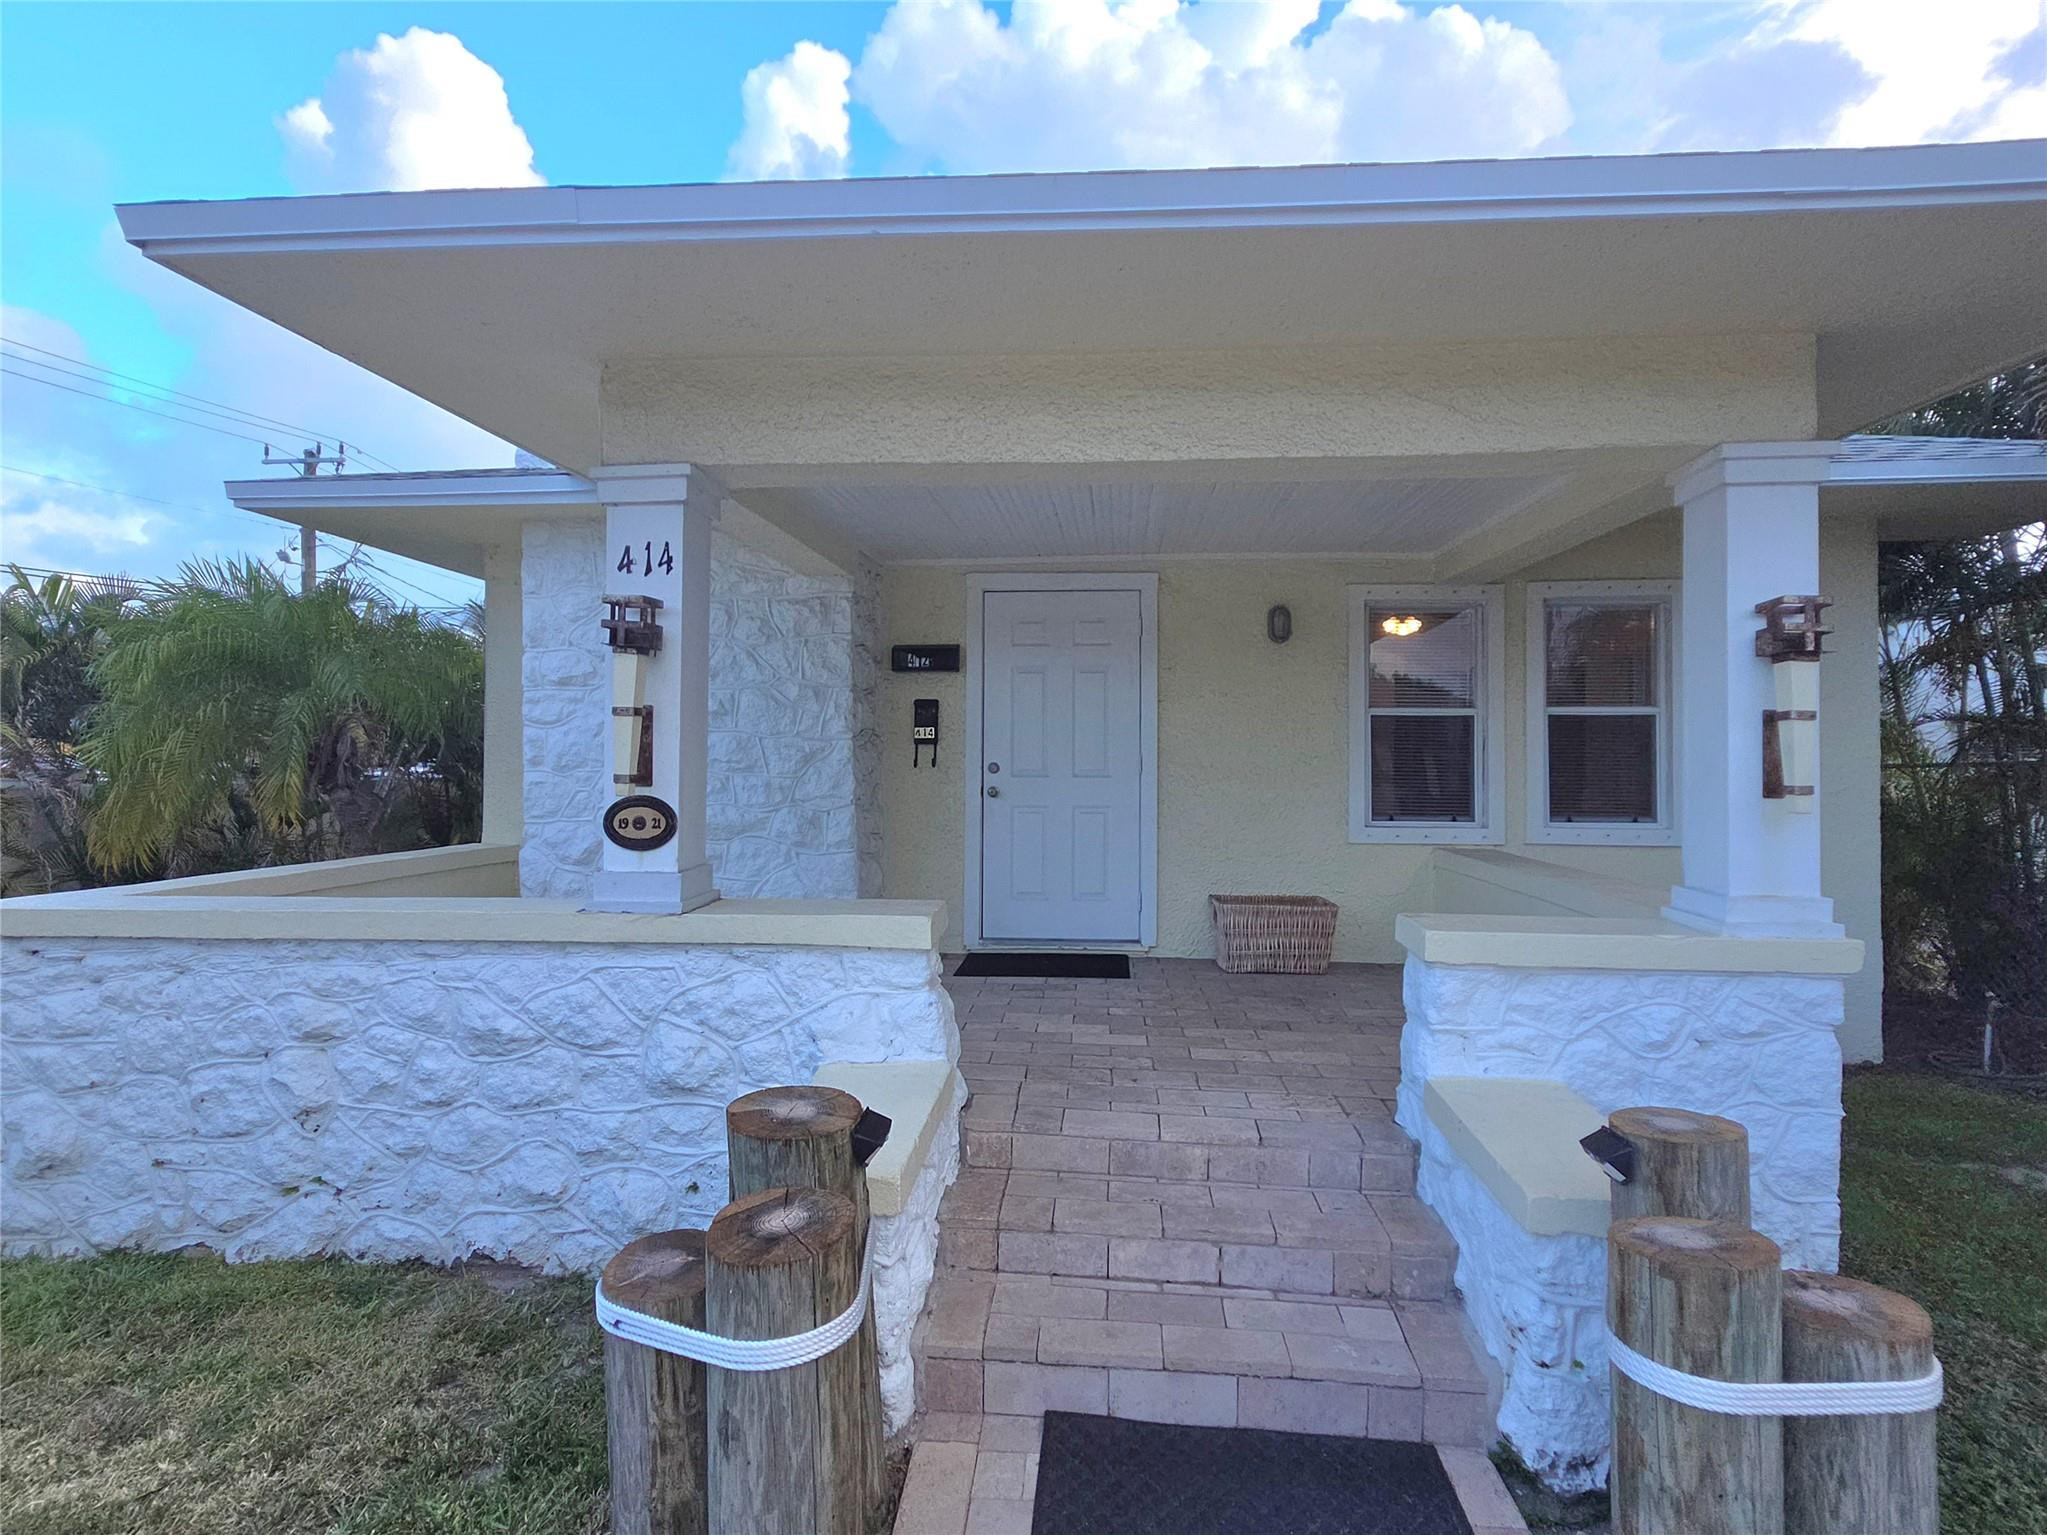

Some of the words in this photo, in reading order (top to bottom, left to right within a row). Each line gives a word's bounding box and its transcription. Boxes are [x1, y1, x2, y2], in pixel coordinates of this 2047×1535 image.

[616, 540, 674, 577] 414
[915, 728, 933, 737] 414
[618, 817, 629, 830] 19
[651, 817, 662, 830] 21
